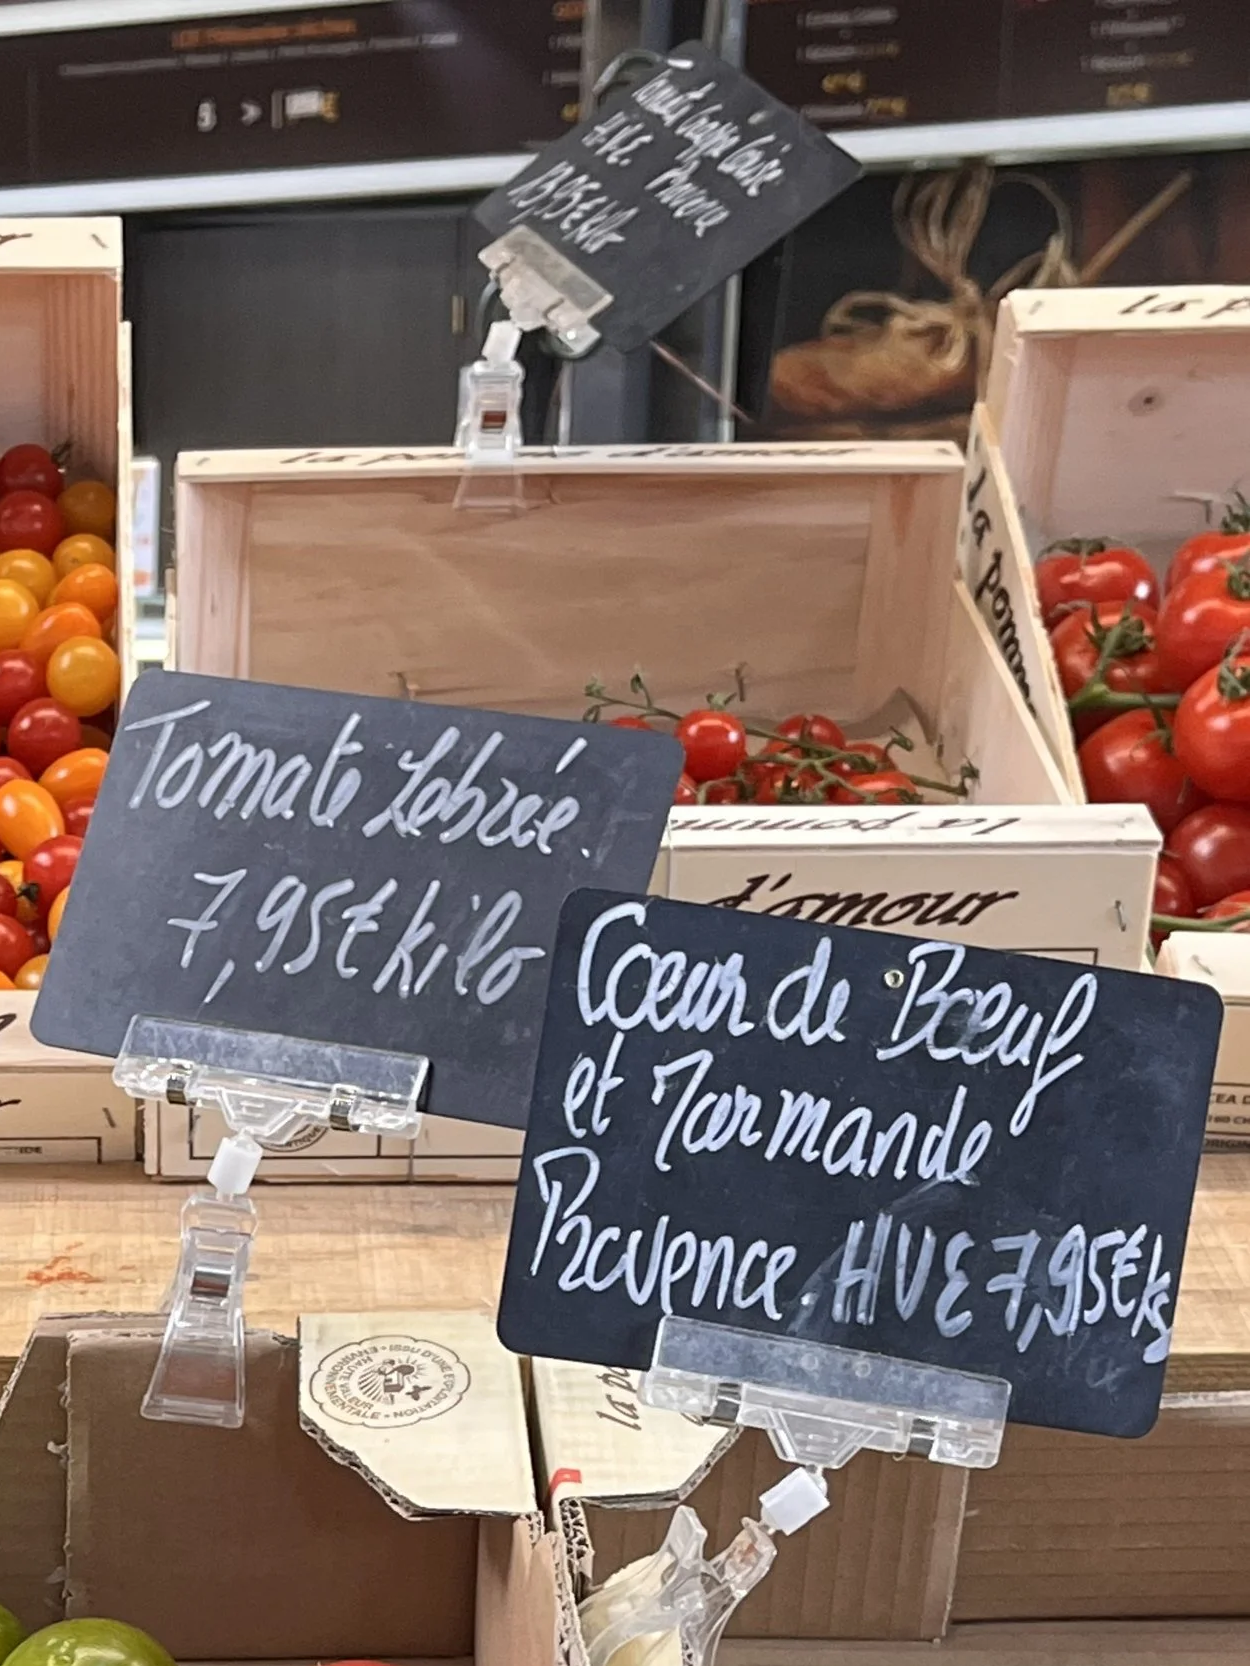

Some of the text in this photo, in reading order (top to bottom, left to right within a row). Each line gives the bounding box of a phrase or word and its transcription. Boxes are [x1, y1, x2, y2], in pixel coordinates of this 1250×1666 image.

[125, 701, 364, 830] Tomate
[766, 936, 849, 1044] de
[563, 1031, 624, 1138] et
